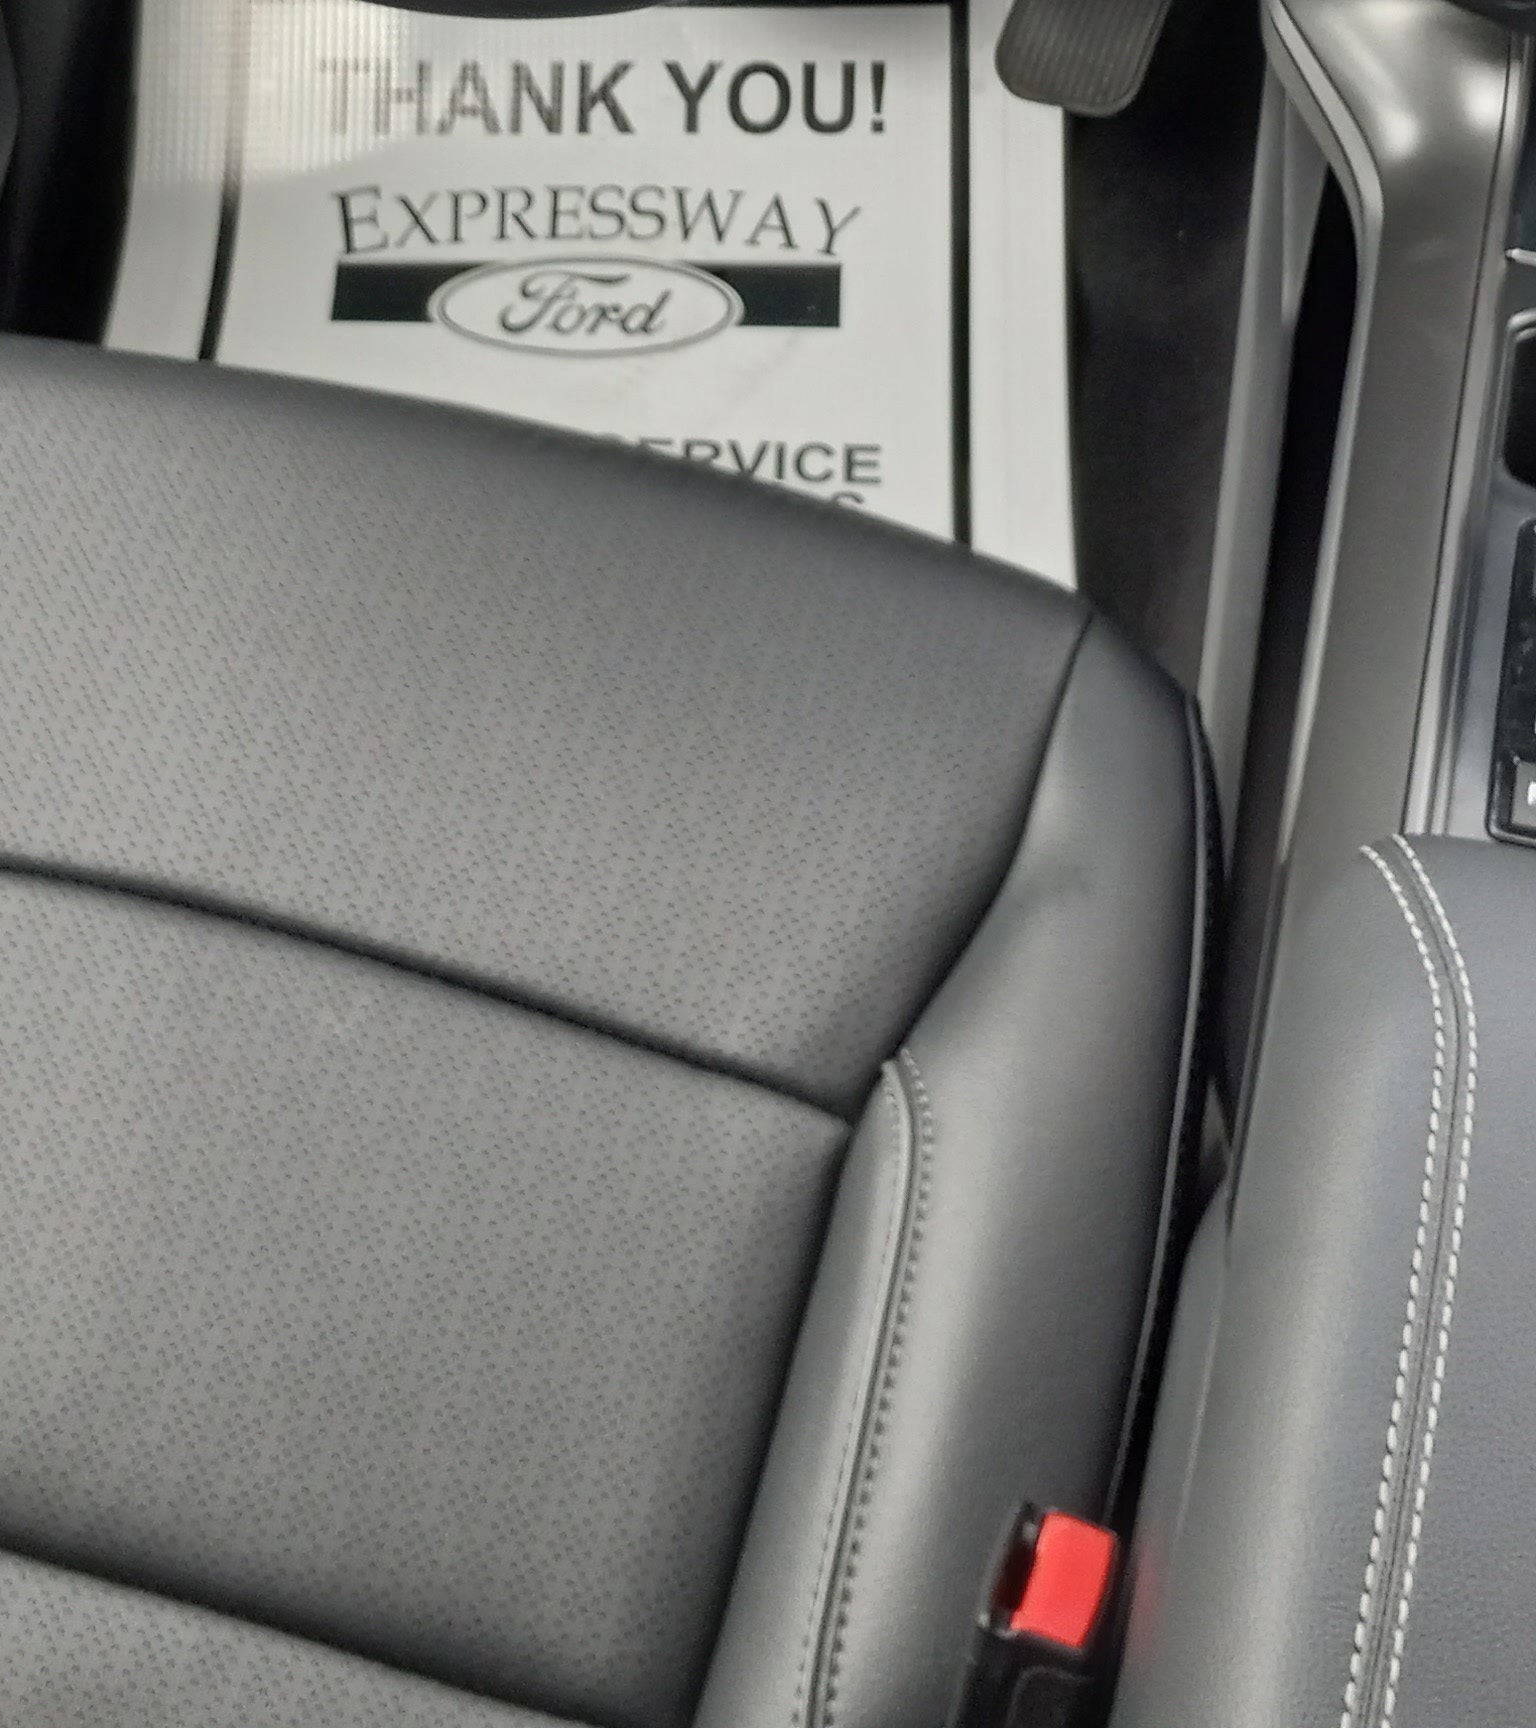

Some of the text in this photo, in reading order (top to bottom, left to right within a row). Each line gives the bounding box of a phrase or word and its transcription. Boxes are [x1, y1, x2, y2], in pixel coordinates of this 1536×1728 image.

[319, 56, 888, 139] THANK YOU!
[498, 270, 670, 340] Ford
[637, 436, 884, 487] RVICE
